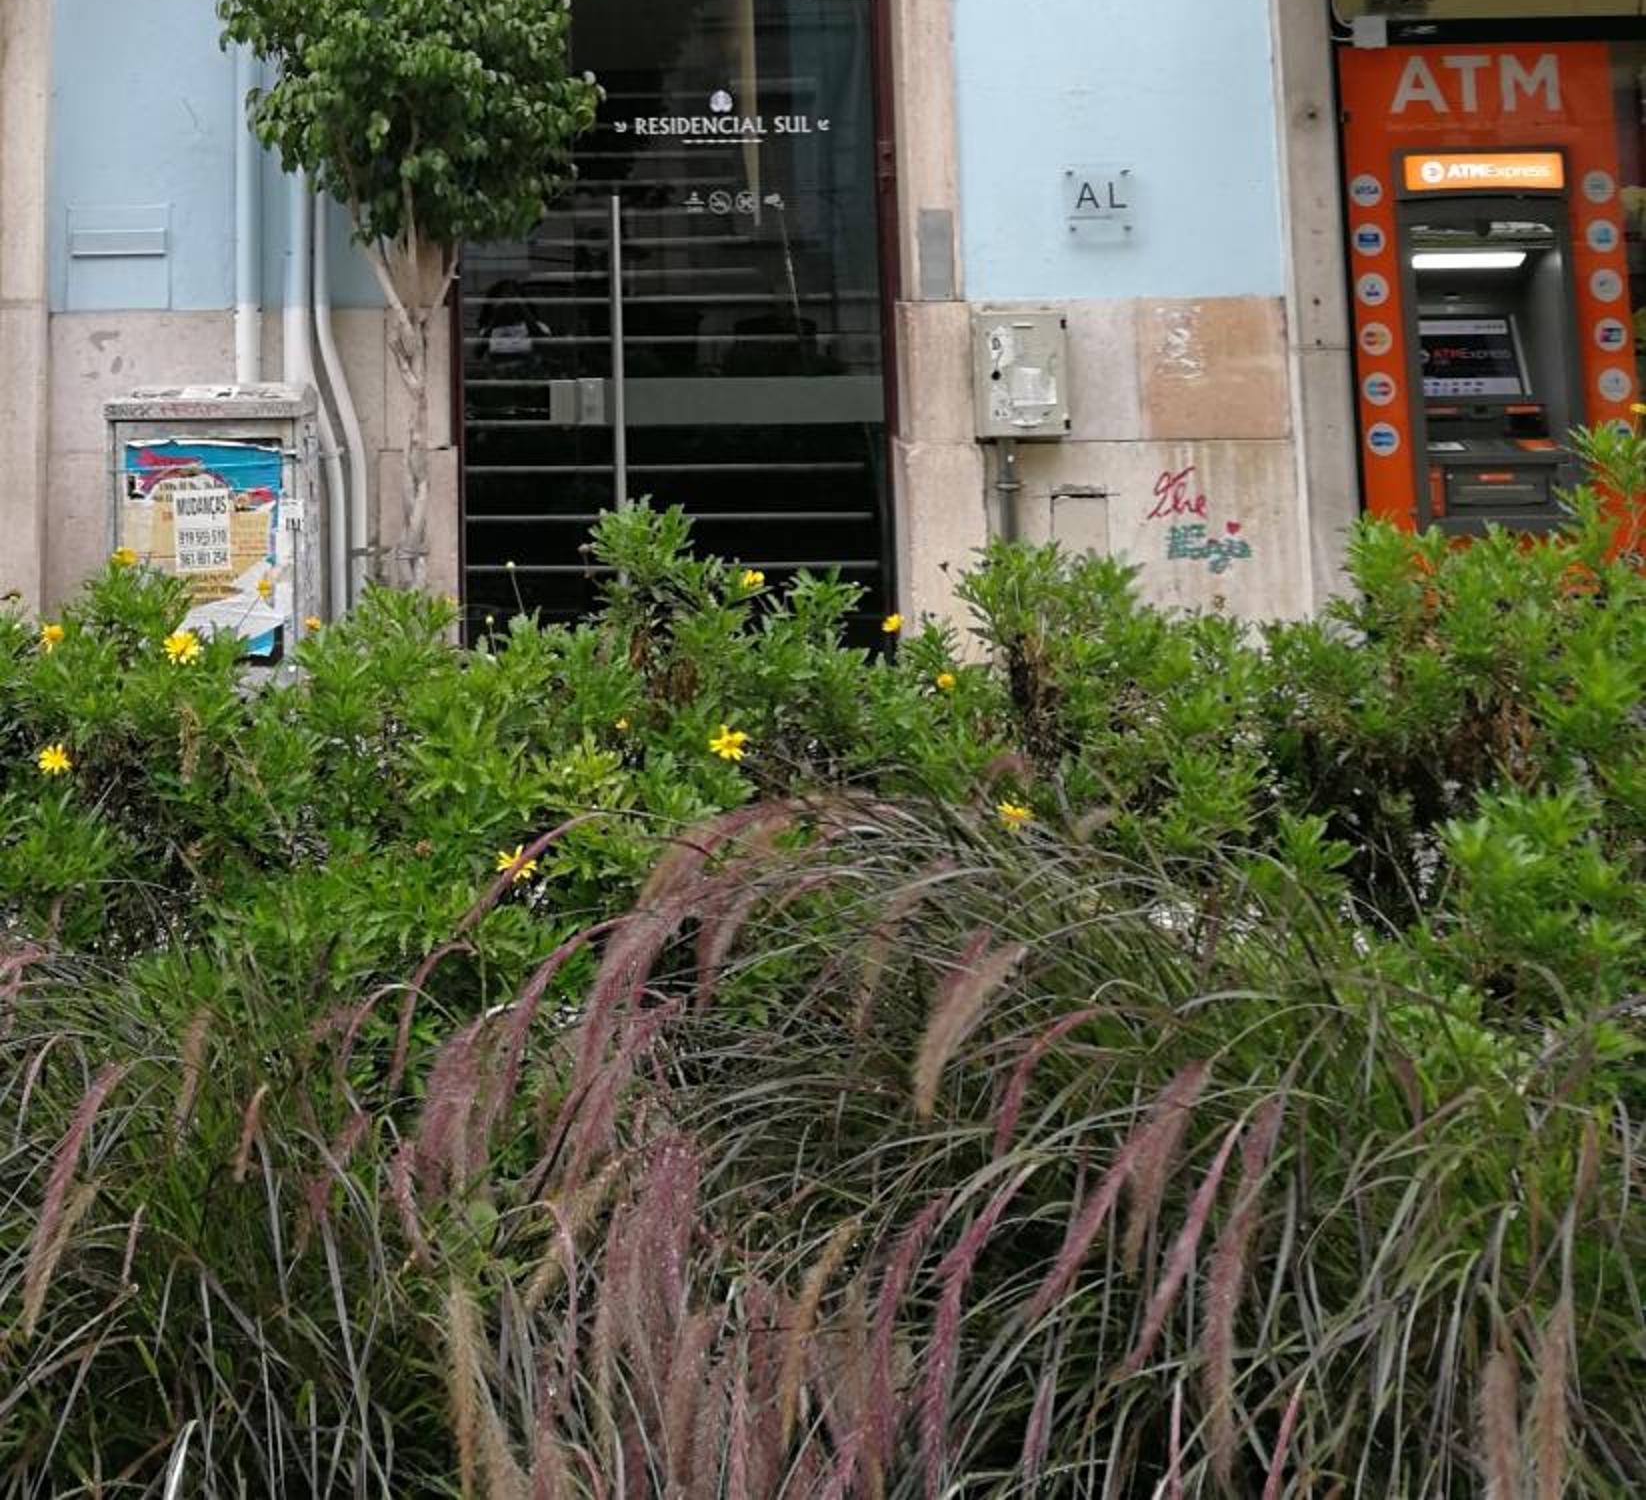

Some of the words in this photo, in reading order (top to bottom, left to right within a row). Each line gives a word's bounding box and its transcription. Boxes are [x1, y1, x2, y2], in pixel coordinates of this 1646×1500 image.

[1389, 53, 1564, 115] ATM
[634, 116, 767, 136] RESIDENCIAL
[774, 115, 812, 134] SUL
[1076, 182, 1128, 209] AL
